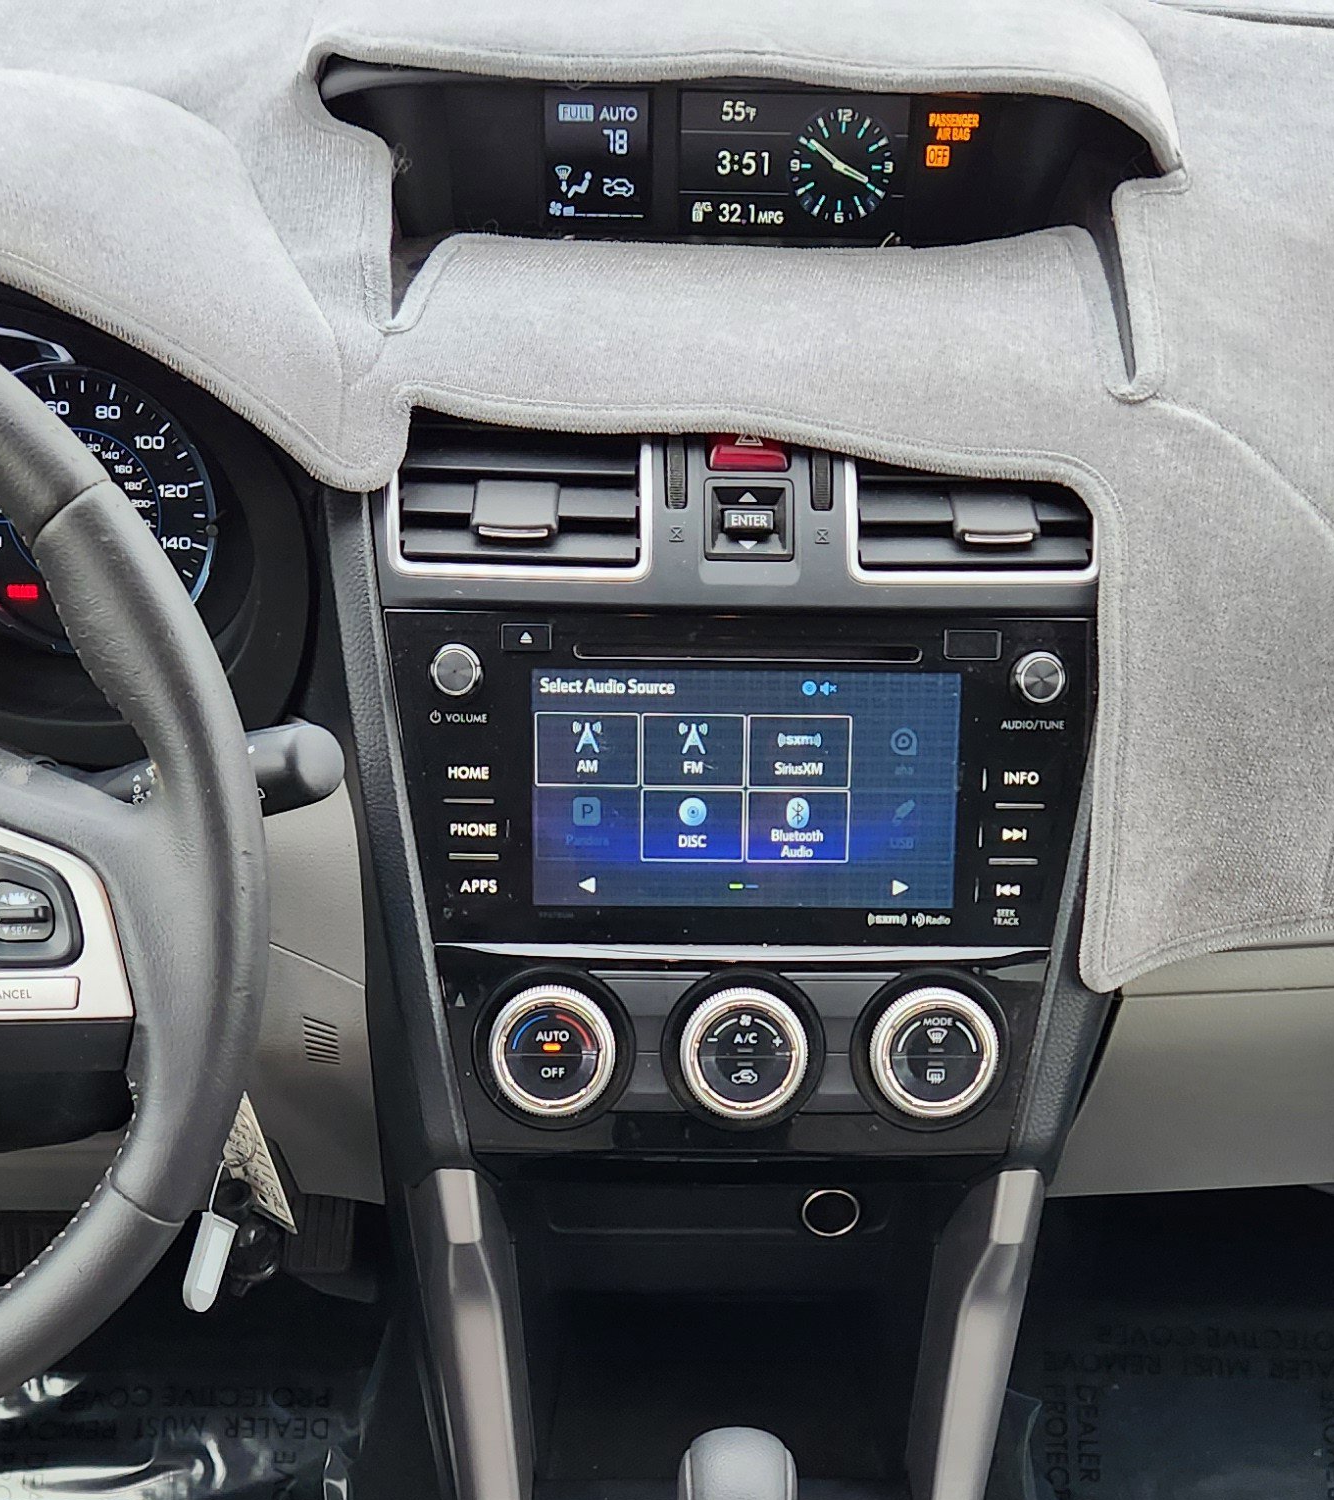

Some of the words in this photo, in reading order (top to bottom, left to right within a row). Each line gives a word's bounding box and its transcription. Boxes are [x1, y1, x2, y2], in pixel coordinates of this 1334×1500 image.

[560, 104, 594, 121] FULL
[599, 107, 638, 121] AUTO
[837, 108, 854, 122] 12
[928, 113, 980, 128] PASSENGER
[603, 130, 628, 154] 78
[717, 151, 770, 176] 3:51
[927, 147, 949, 166] OFF
[790, 159, 800, 172] 9
[883, 161, 894, 174] 3
[834, 212, 844, 224] 6
[95, 405, 121, 419] 80
[134, 436, 165, 450] 100
[158, 484, 189, 498] 120
[731, 515, 767, 526] ENTER
[161, 537, 191, 550] 140
[539, 677, 582, 694] Select
[585, 678, 626, 694] Audio
[628, 679, 675, 695] Source
[446, 713, 488, 724] VOLUME
[1001, 719, 1064, 731] AUDIO/TUNE
[447, 766, 490, 780] HOME
[576, 760, 599, 773] AM
[683, 761, 704, 775] FM
[774, 762, 823, 775] SiriusXM
[1004, 771, 1040, 786] INFO
[450, 823, 498, 837] PHONE
[771, 829, 823, 842] Bluetooth
[678, 834, 707, 848] DISC
[780, 845, 814, 858] Audio
[460, 880, 498, 893] APPS
[996, 909, 1015, 917] SEEK
[993, 917, 1019, 926] TRACK
[922, 1017, 954, 1027] MODE
[535, 1030, 570, 1043] AUTO
[733, 1032, 758, 1045] A/C
[541, 1067, 565, 1079] OFF
[1096, 1323, 1196, 1347] COVER
[1044, 1350, 1161, 1376] REMOVE
[1182, 1355, 1250, 1378] MUST
[167, 1383, 334, 1410] PROTECTIVE
[133, 1414, 207, 1440] MUST
[224, 1414, 330, 1440] DEALER
[1075, 1384, 1102, 1484] DEALER
